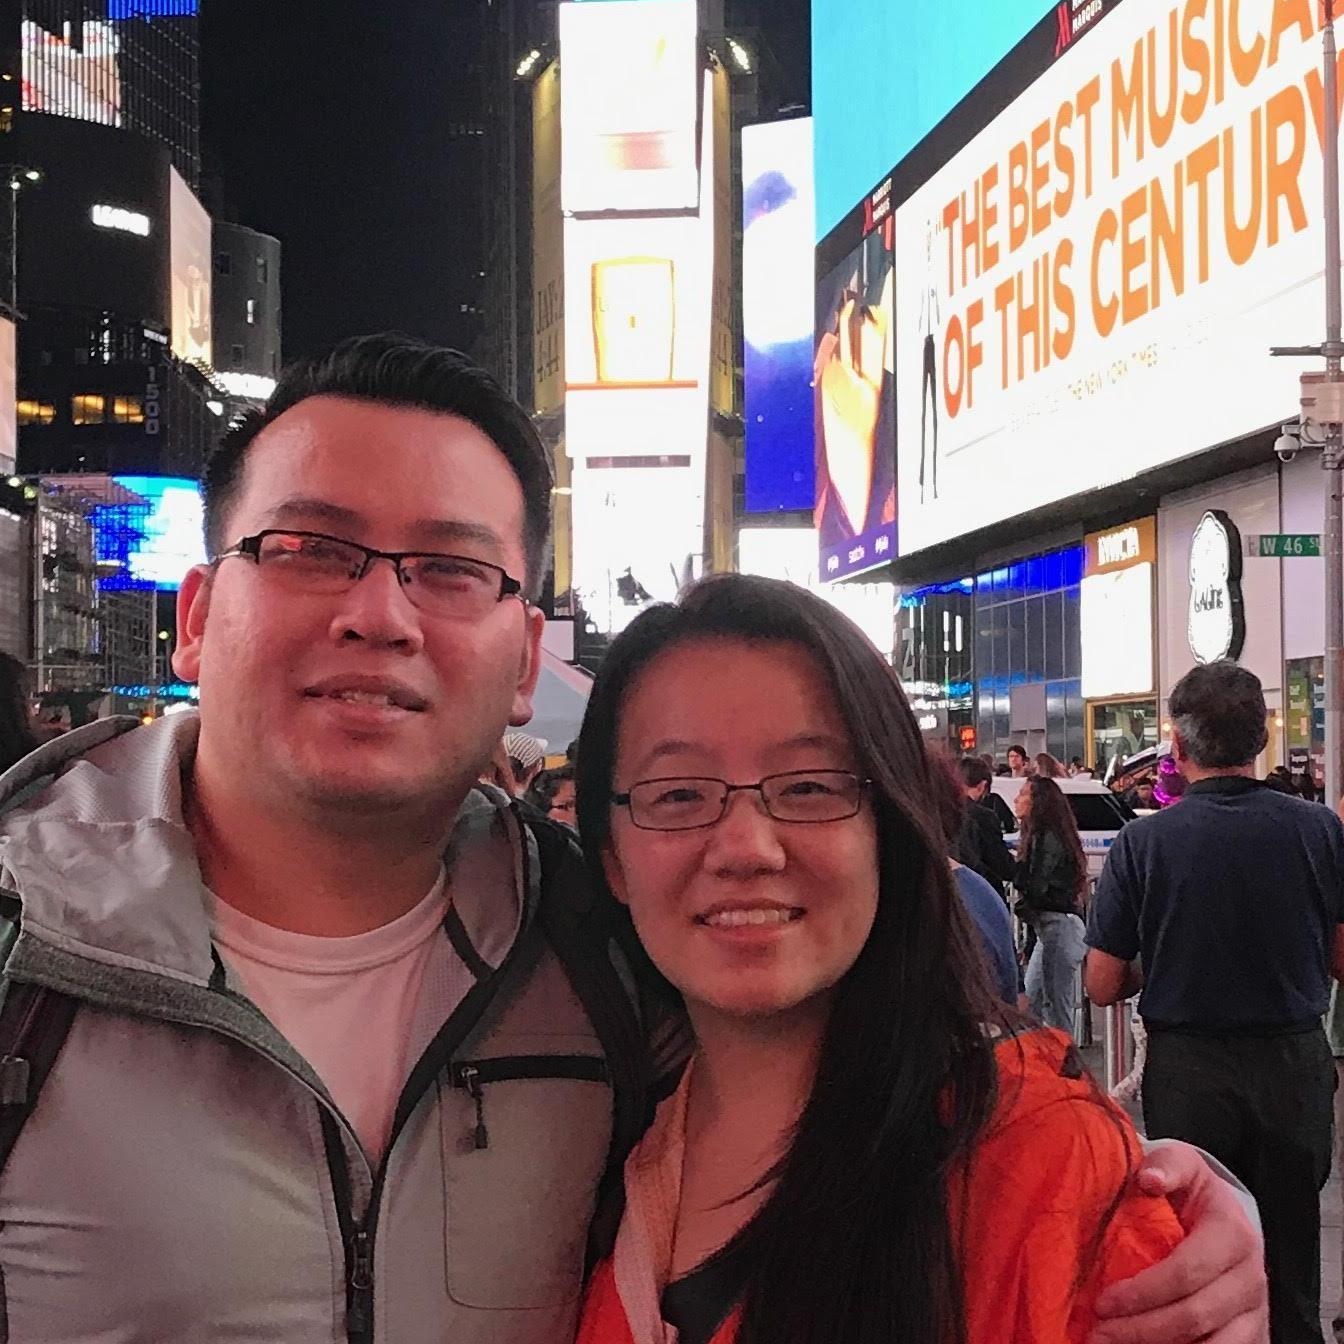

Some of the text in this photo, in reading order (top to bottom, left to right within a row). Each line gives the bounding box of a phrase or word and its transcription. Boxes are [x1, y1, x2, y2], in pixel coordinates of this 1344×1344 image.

[1008, 75, 1100, 254] BEST
[942, 296, 984, 422] OF
[994, 241, 1076, 392] THIS
[1262, 537, 1276, 555] W
[1283, 537, 1303, 554] 46
